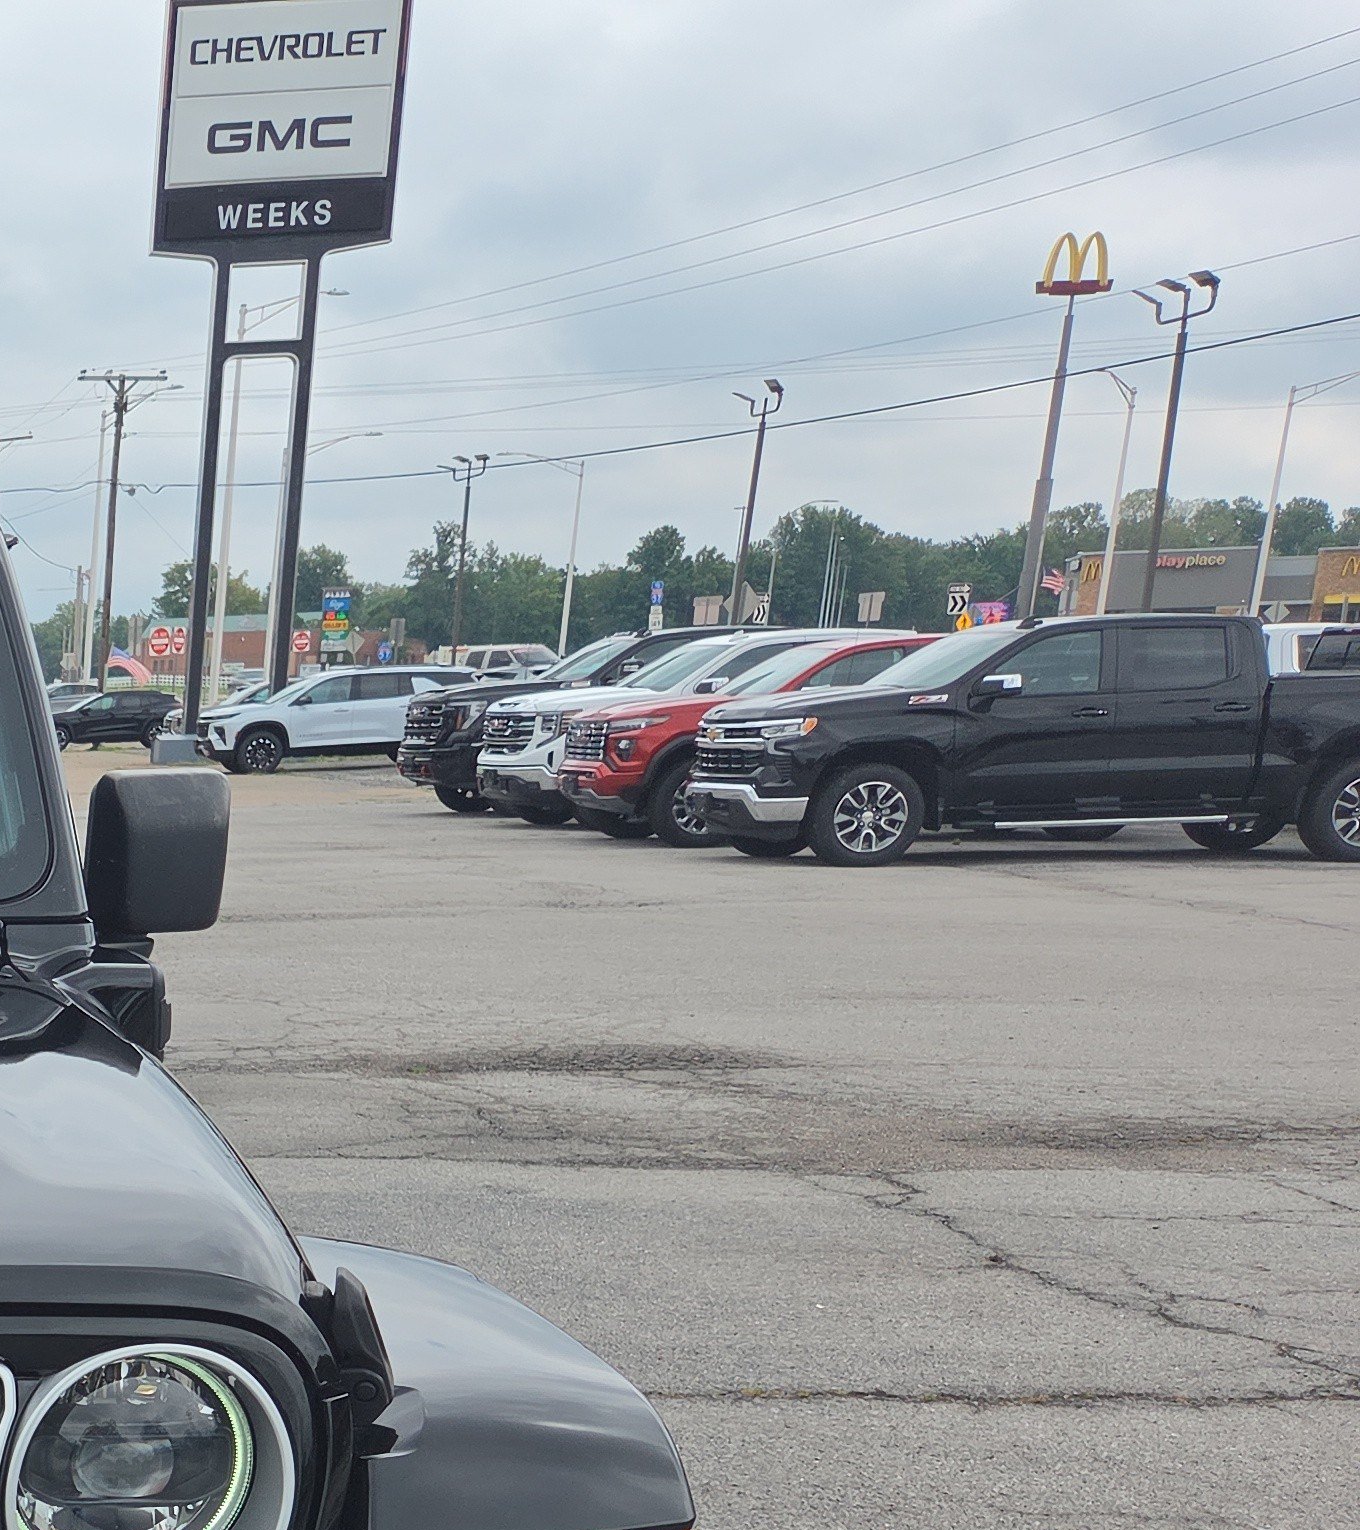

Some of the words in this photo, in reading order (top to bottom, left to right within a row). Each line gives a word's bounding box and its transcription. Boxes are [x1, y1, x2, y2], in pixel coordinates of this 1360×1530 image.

[190, 29, 387, 66] CHEVROLET
[207, 115, 353, 155] GMC
[218, 200, 333, 230] WEEKS
